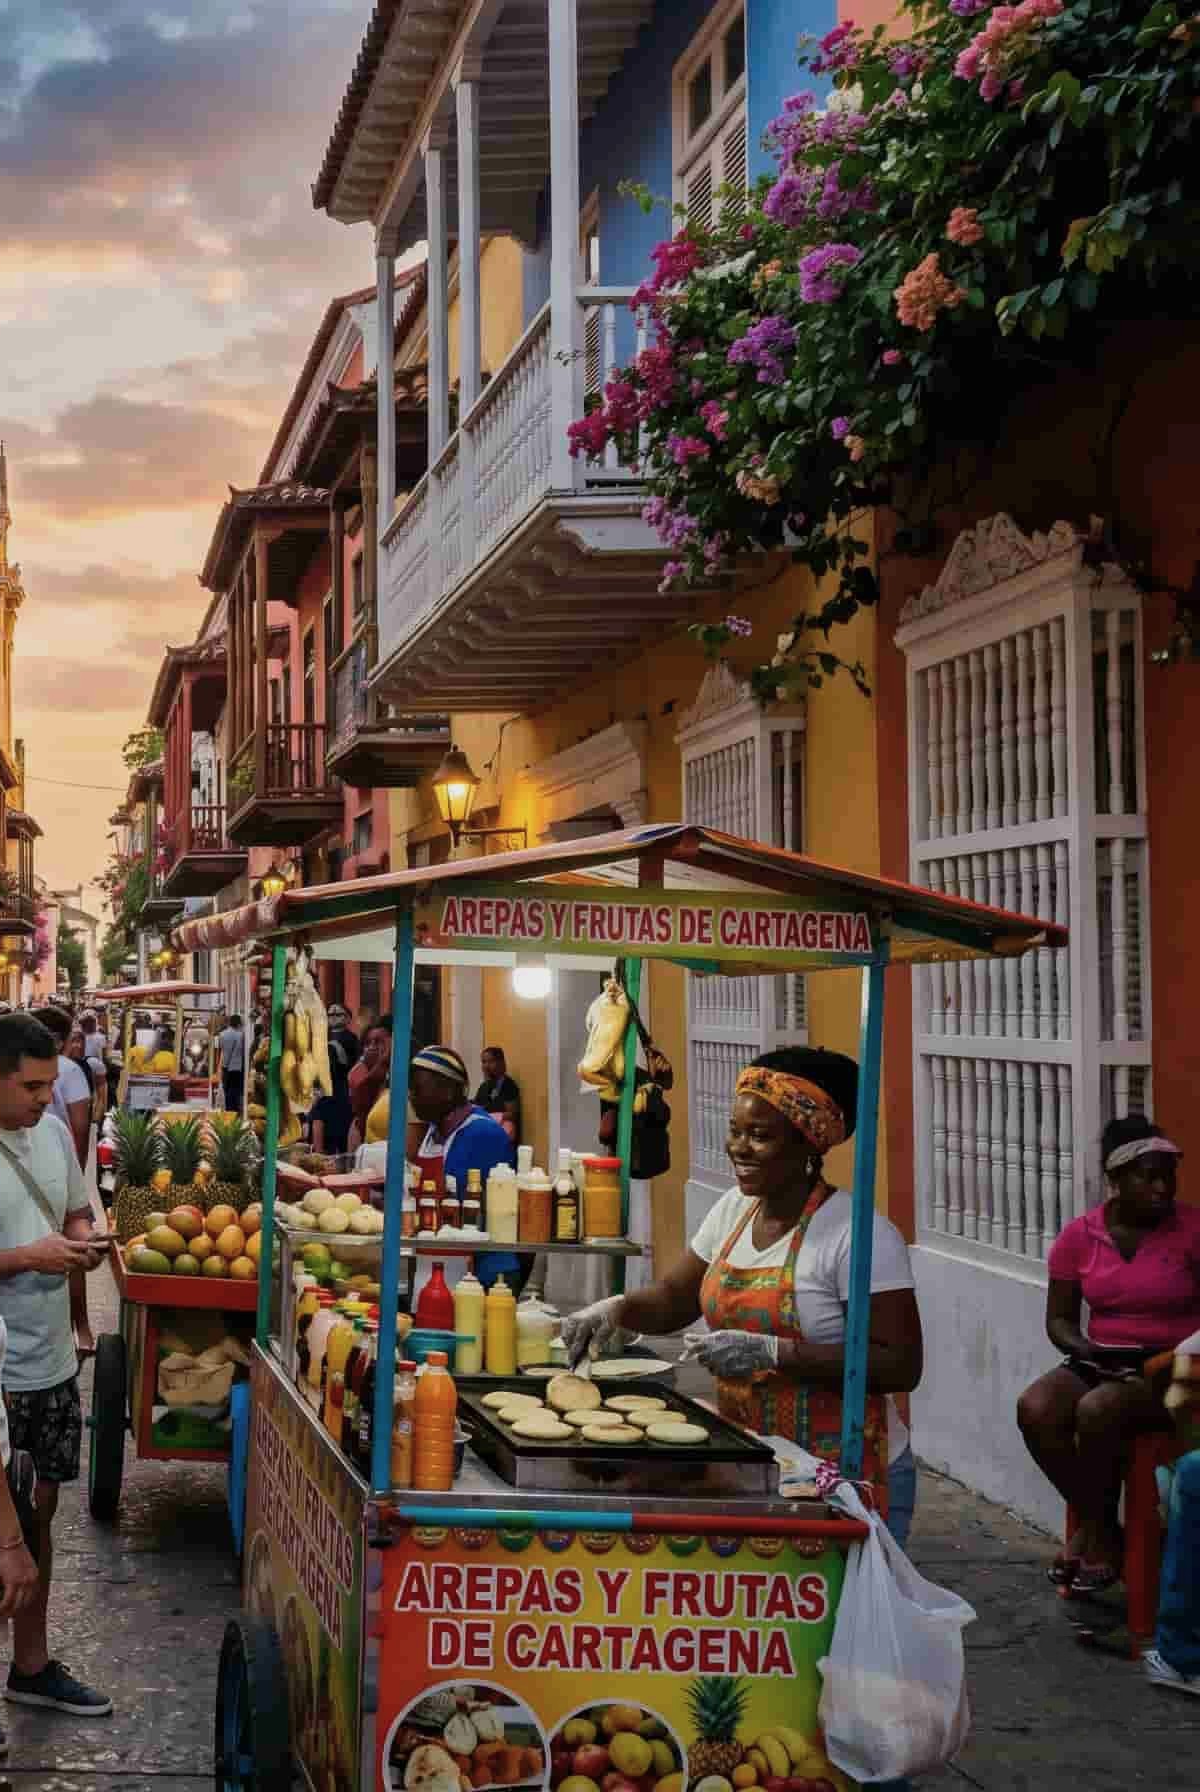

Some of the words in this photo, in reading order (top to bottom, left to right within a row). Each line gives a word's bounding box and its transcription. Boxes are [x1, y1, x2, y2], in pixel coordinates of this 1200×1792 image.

[440, 896, 545, 940] AREPAS
[548, 900, 570, 942] Y
[572, 901, 673, 945] FRUTAS
[677, 905, 714, 946] DE
[719, 907, 873, 953] CARTAGENA
[304, 1473, 354, 1596] FRUTAS
[395, 1561, 583, 1615] AREPAS
[595, 1567, 631, 1616] Y
[642, 1569, 828, 1624] FRUTAS
[428, 1617, 494, 1670] DE
[505, 1621, 797, 1679] CARTAGENA
